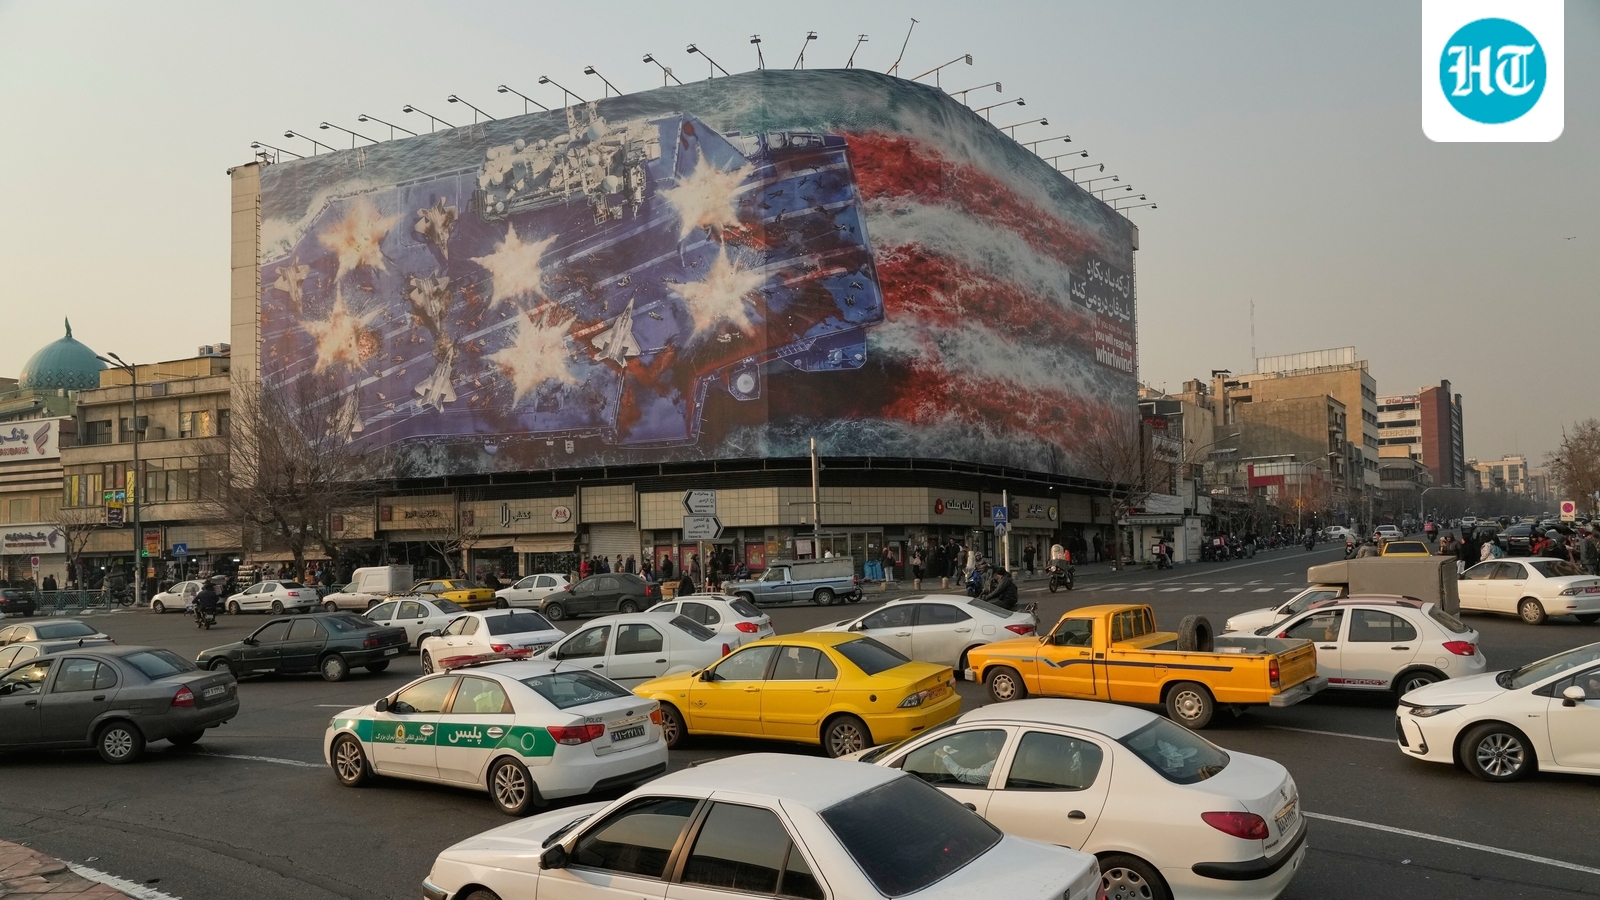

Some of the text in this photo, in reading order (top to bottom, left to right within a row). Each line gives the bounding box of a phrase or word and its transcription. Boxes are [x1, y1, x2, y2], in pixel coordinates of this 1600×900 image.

[1094, 330, 1104, 342] you
[1105, 333, 1114, 346] will
[1114, 338, 1124, 352] reap
[1095, 344, 1133, 373] whirlwind
[512, 510, 531, 523] کفش
[946, 499, 974, 514] بانک ملت
[448, 725, 482, 745] پلیس
